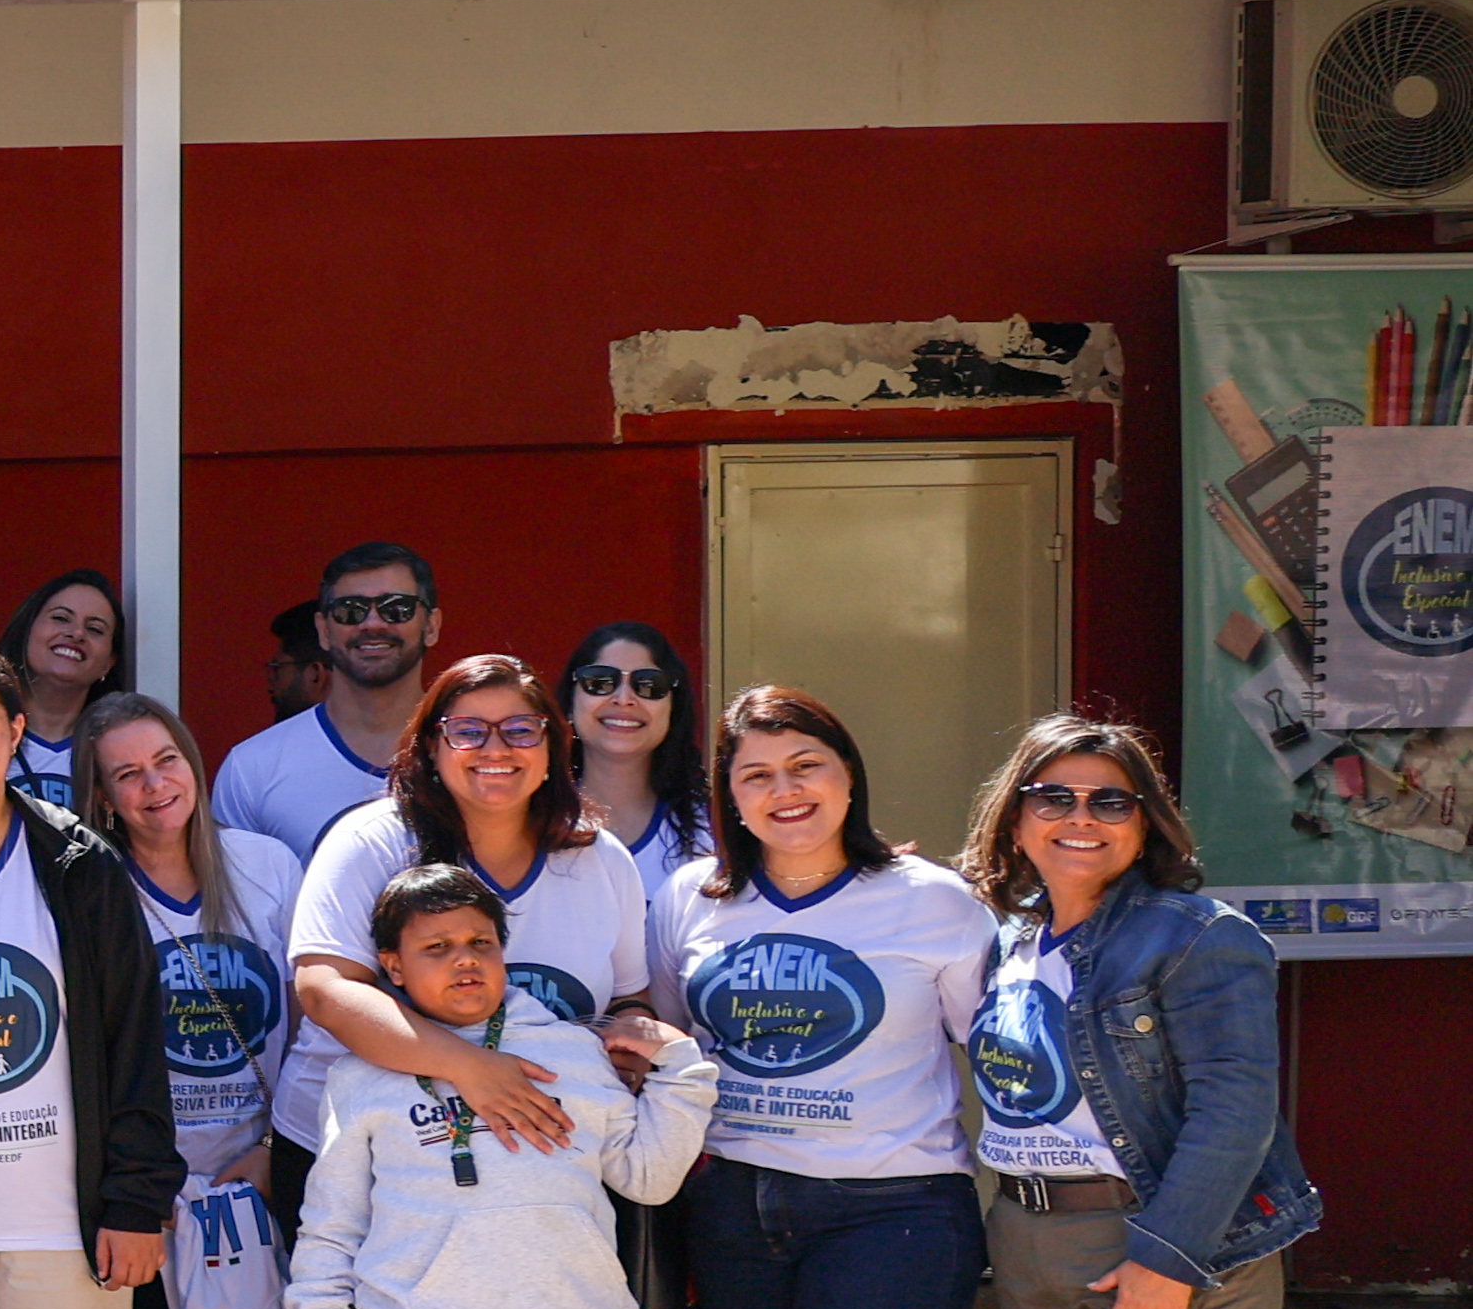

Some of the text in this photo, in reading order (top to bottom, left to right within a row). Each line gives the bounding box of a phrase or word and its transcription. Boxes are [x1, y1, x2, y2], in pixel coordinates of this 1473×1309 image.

[1402, 585, 1470, 613] Especial
[1345, 910, 1376, 924] GDF
[168, 943, 247, 990] ENEM
[730, 943, 828, 991] ENEM
[731, 996, 809, 1019] Inclusivo
[219, 1082, 233, 1093] DE
[767, 1086, 784, 1098] DE
[787, 1087, 854, 1104] EDUCAÇÃO
[209, 1095, 216, 1109] E
[756, 1098, 766, 1110] E
[769, 1100, 852, 1121] INTEGRAL
[9, 1102, 58, 1125] EDUCAÇÃO
[1024, 1136, 1037, 1148] DE
[1017, 1151, 1094, 1167] E INTEGRA
